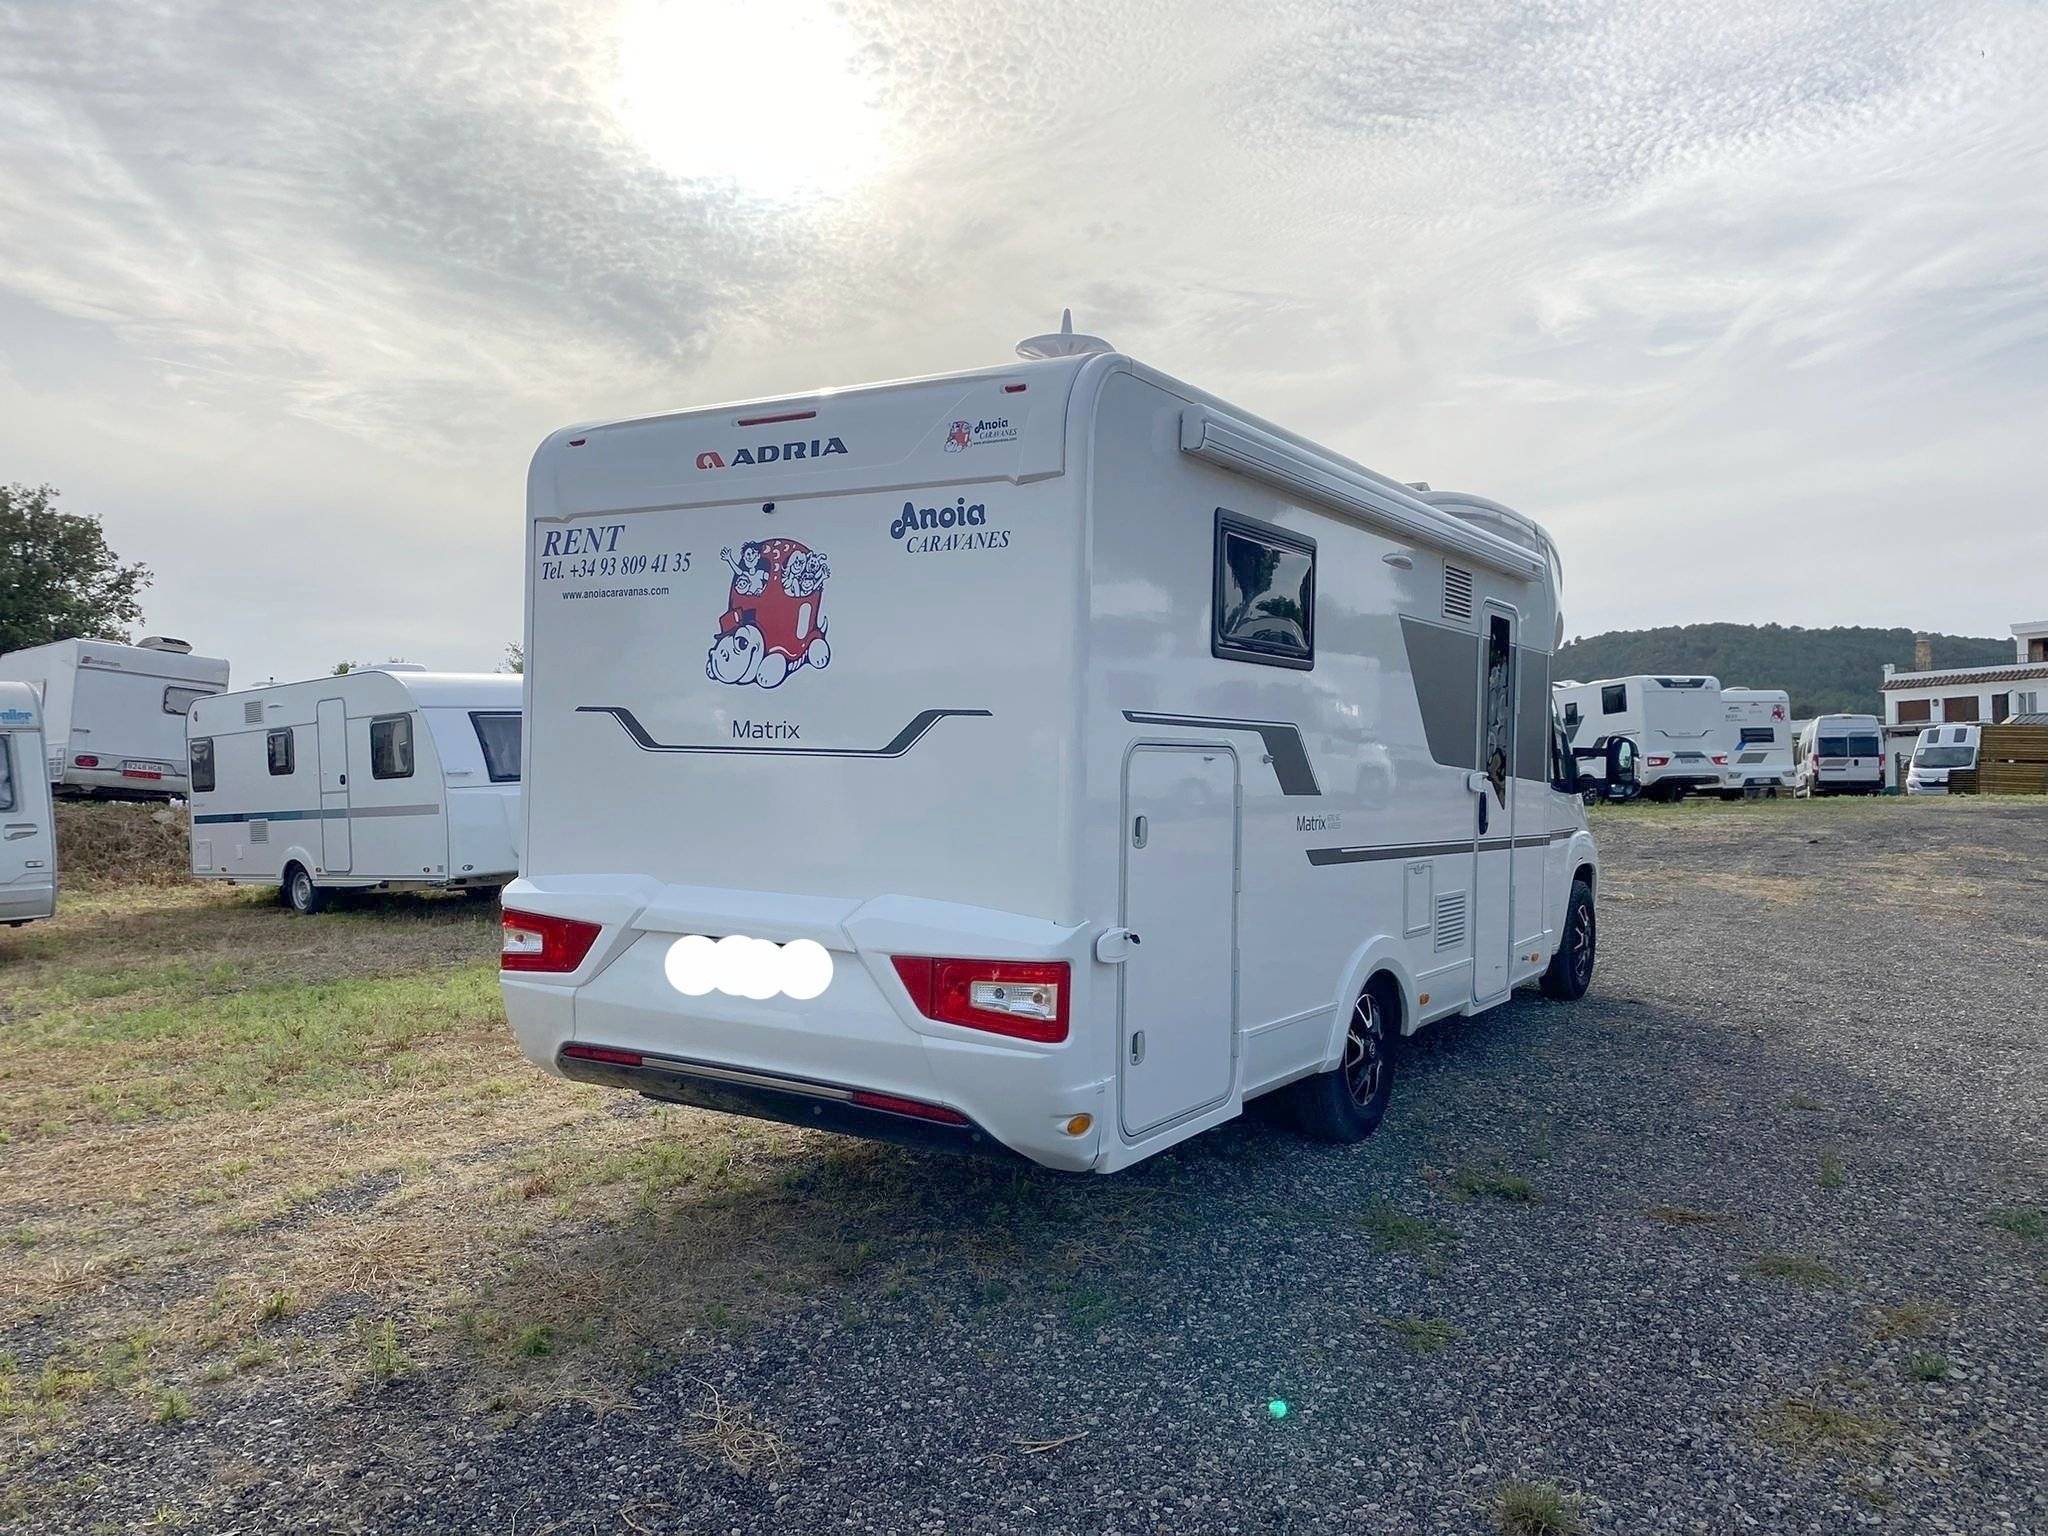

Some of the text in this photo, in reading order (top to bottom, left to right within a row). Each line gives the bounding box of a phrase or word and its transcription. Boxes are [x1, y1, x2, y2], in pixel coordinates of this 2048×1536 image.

[974, 417, 1009, 434] Anoia
[731, 437, 848, 466] ADRIA
[890, 497, 986, 540] Anoia
[541, 525, 626, 557] RENT
[906, 530, 1011, 554] CARAVANES
[542, 552, 692, 580] Tel. +34 93 809 41 35
[562, 586, 670, 600] www.anoiacaravanas.com
[732, 720, 801, 739] Matrix
[1296, 815, 1327, 831] Matrix
